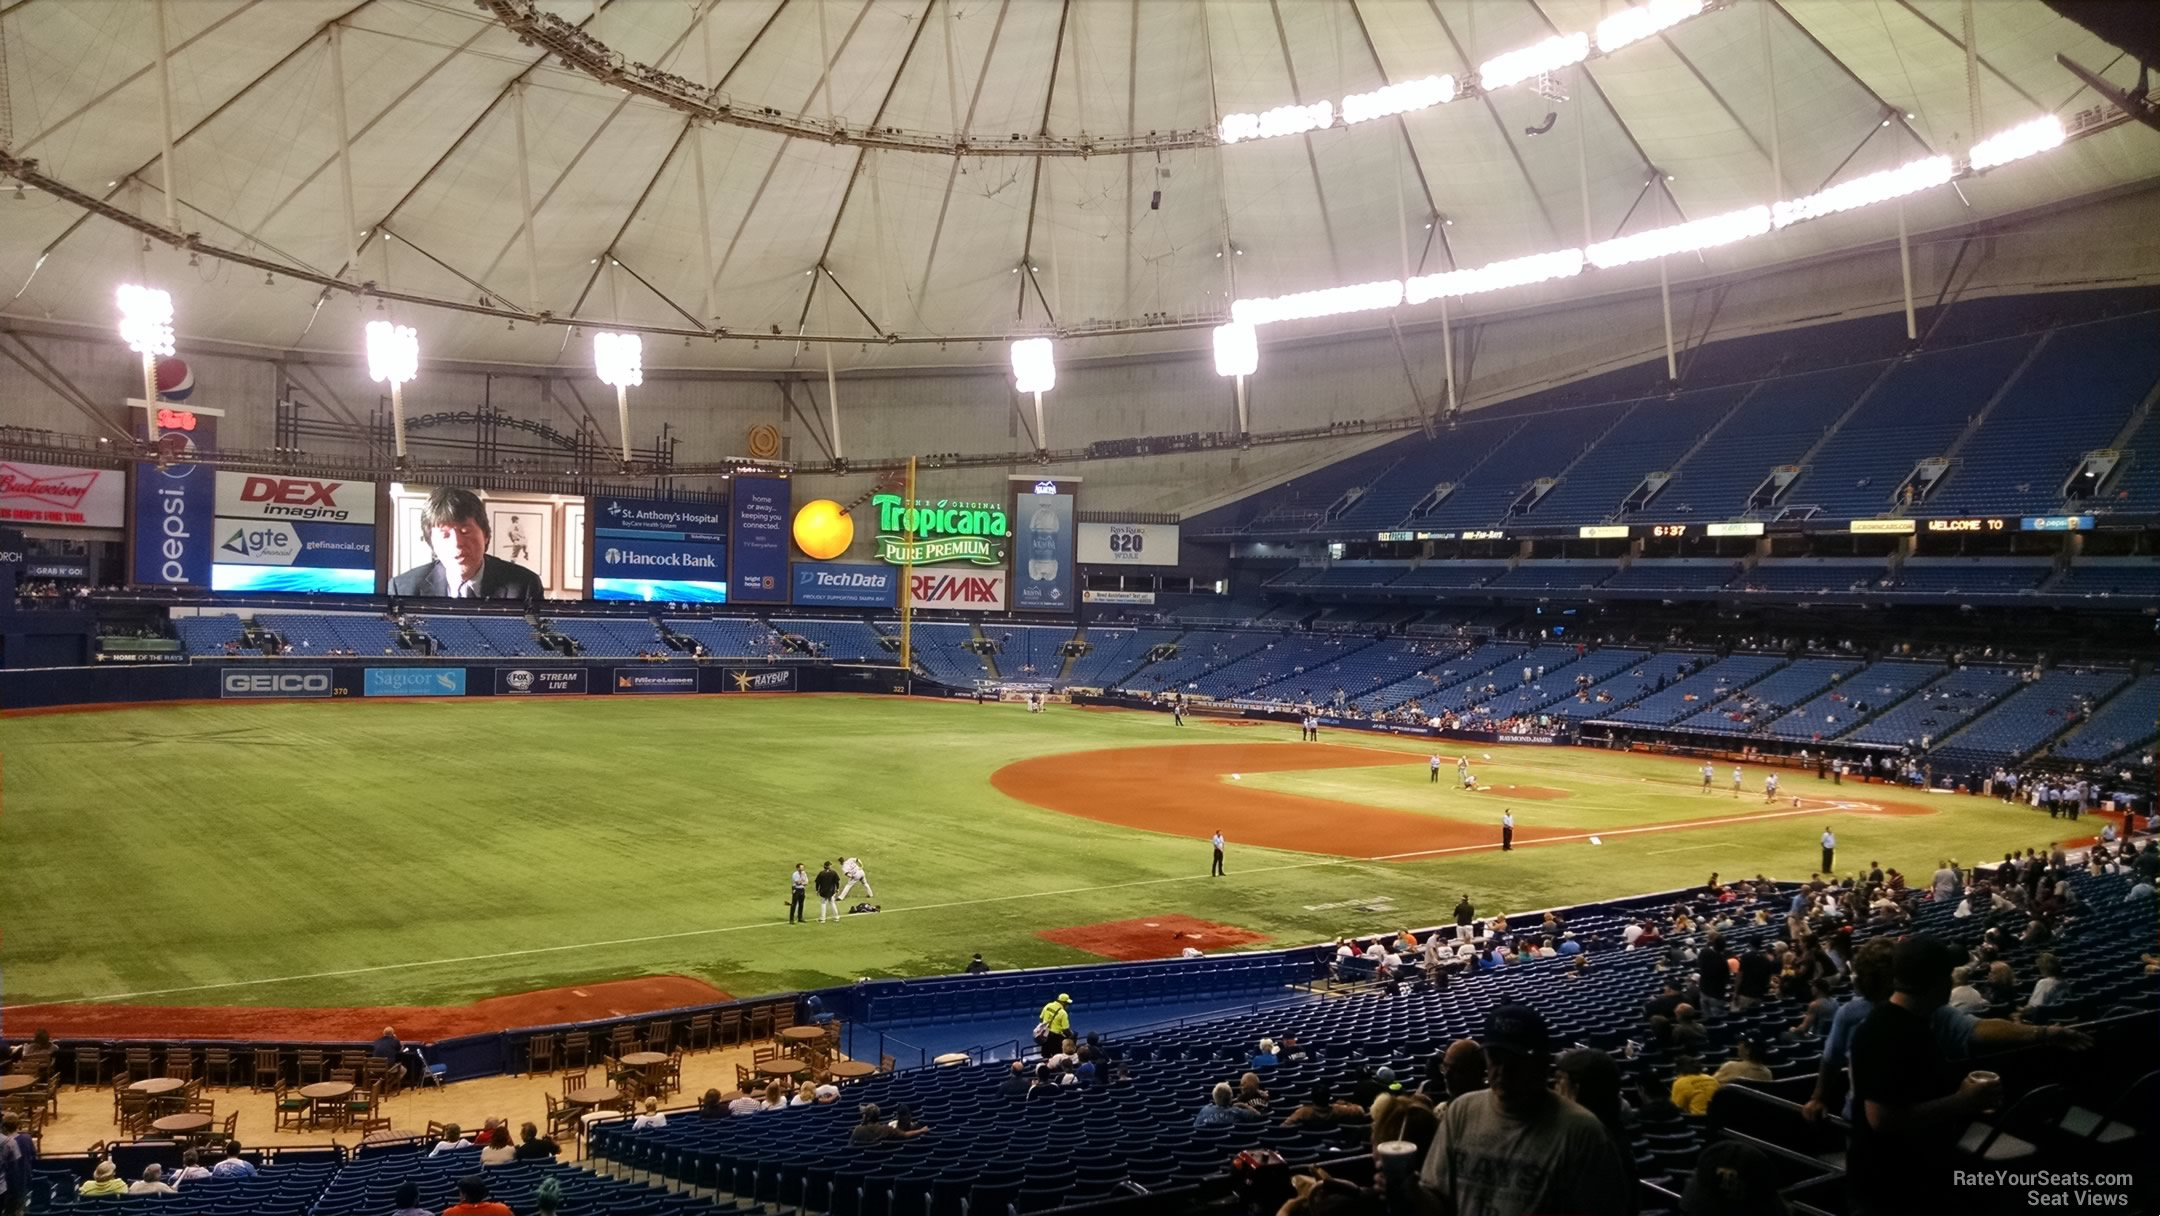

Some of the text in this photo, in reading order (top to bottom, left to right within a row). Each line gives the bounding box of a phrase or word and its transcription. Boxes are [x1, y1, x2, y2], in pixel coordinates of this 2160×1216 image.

[240, 476, 343, 507] DEX
[752, 495, 772, 503] home
[952, 501, 1001, 510] ORIGINAL
[264, 503, 349, 520] imaging
[622, 509, 718, 525] St. Anthony's Hospital
[741, 511, 768, 521] keeping
[872, 494, 1008, 538] Tropicana
[742, 522, 780, 530] connected.
[1653, 525, 1686, 537] 6:37
[1928, 520, 2003, 531] WELCOME TO
[158, 489, 190, 582] pepsi
[249, 529, 288, 551] gte
[1378, 532, 1390, 541] FLEX
[306, 542, 370, 552] gtefinancial.org
[886, 541, 990, 560] PURE PREMIUM
[1110, 534, 1143, 553] 620
[256, 547, 293, 557] financial
[622, 551, 716, 567] Hancock Bank
[36, 567, 58, 575] GRAB
[911, 575, 999, 602] RE/MAX
[225, 675, 328, 692] GEICO
[375, 670, 432, 689] Sagicor
[540, 673, 577, 681] STREAM
[1499, 735, 1531, 743] RAYMOND
